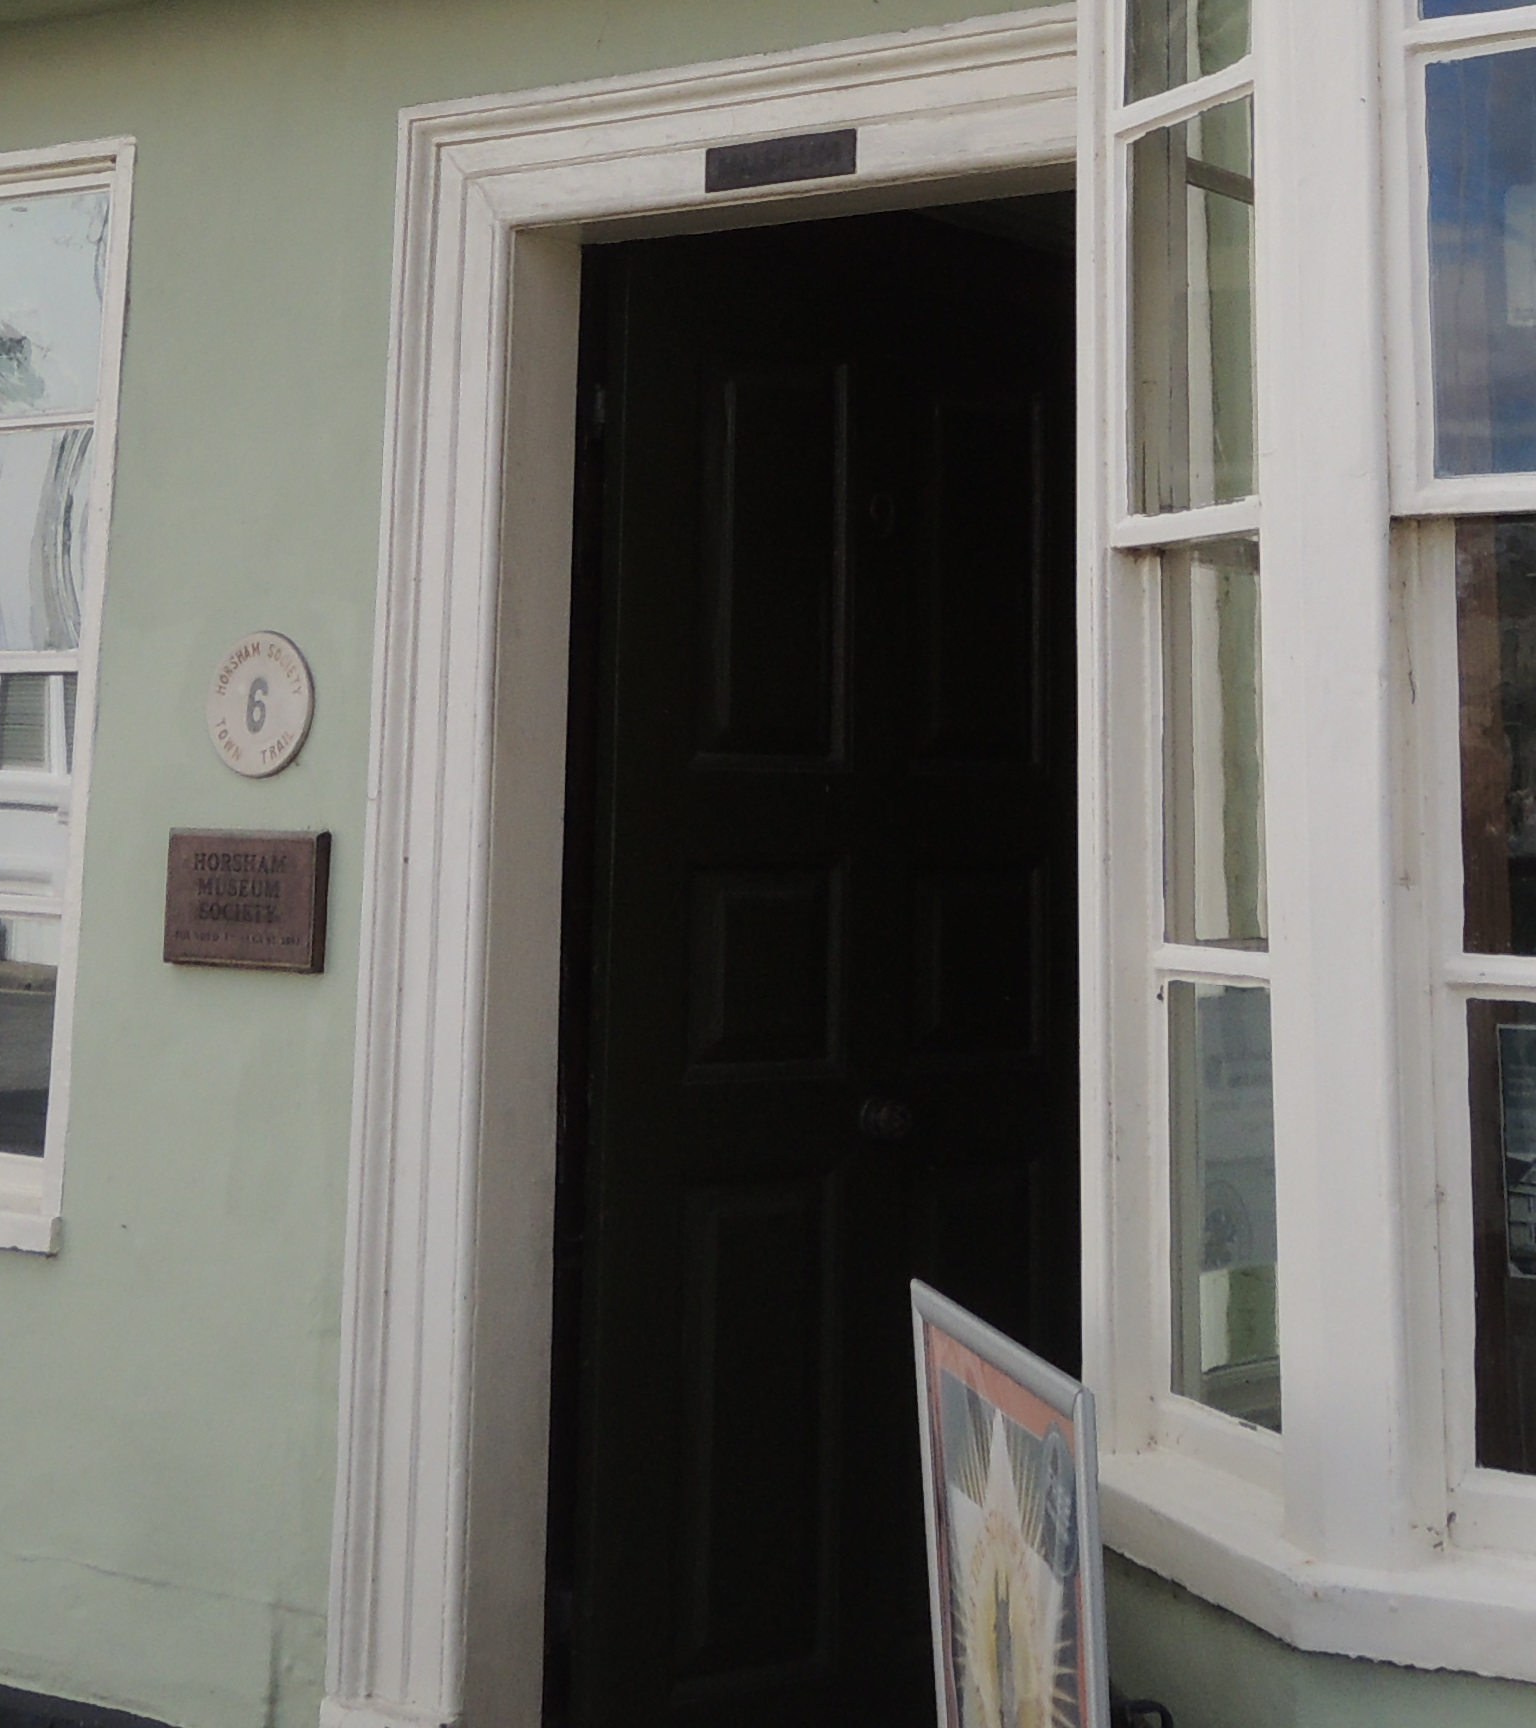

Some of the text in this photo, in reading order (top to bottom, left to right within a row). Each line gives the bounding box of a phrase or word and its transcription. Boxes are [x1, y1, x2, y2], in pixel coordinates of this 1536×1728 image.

[215, 641, 302, 696] HORSHAM SOCIETY
[245, 676, 270, 735] 6
[215, 717, 294, 764] TOWN TRAIL
[193, 852, 287, 874] HORSHAM
[197, 877, 281, 899] MUSEUM
[197, 900, 278, 923] SOCIETY
